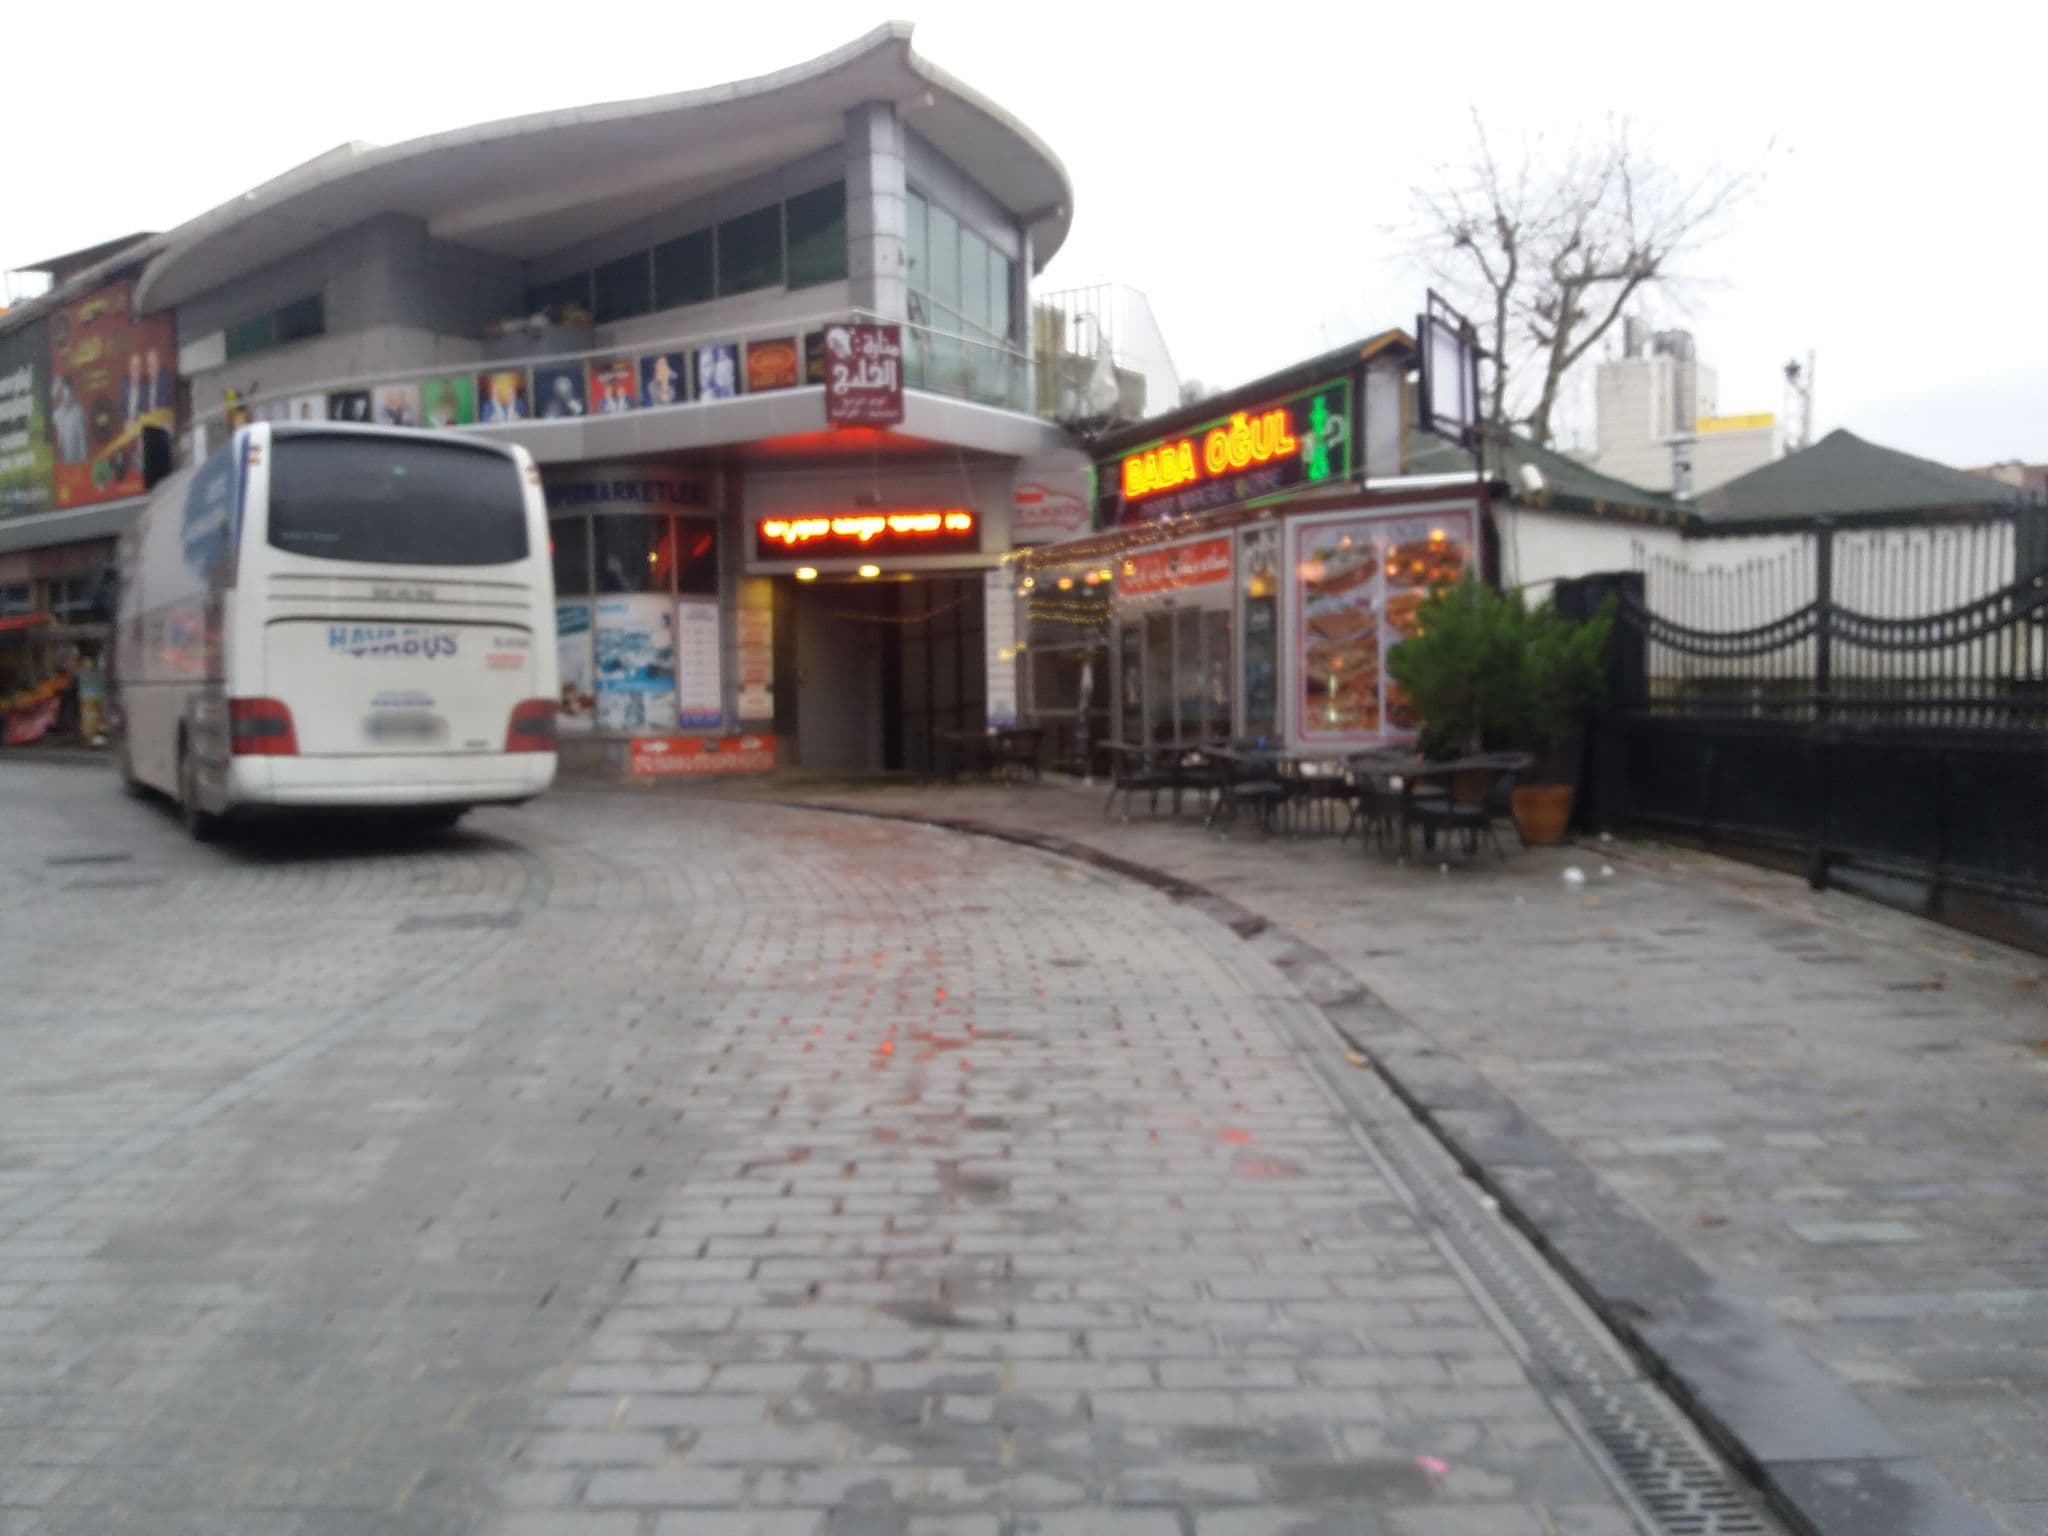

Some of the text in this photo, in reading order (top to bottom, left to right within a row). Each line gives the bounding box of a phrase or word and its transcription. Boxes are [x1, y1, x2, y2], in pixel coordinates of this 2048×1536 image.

[833, 358, 897, 395] الخليج
[1122, 438, 1197, 499] BABA
[1204, 410, 1298, 476] OĞUL
